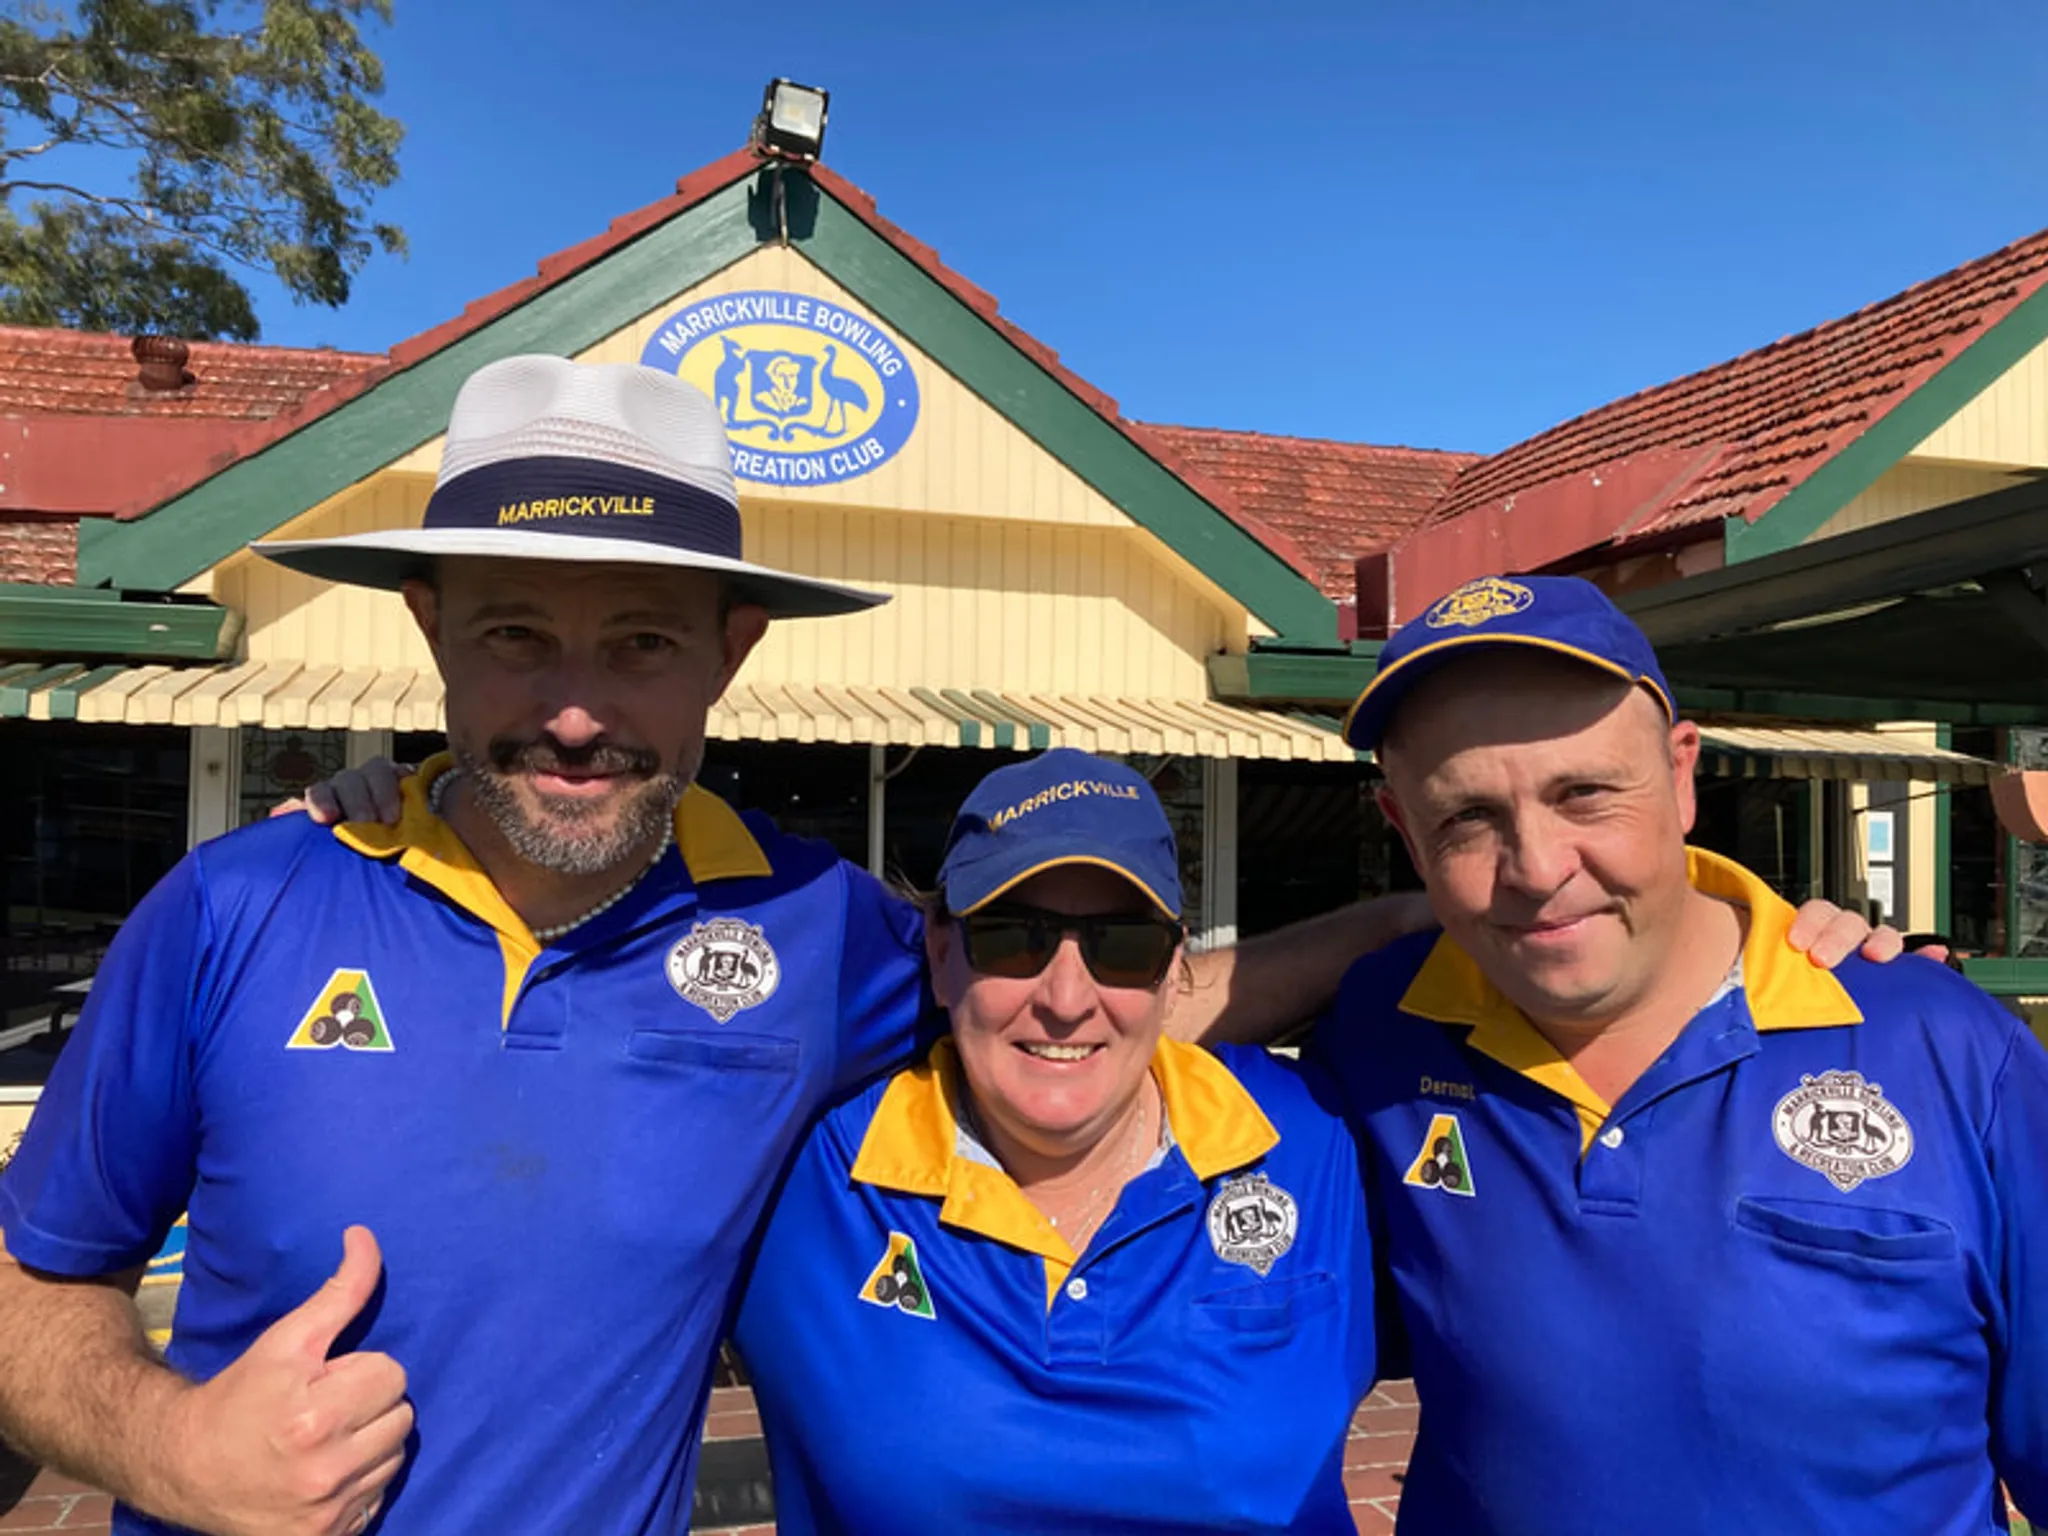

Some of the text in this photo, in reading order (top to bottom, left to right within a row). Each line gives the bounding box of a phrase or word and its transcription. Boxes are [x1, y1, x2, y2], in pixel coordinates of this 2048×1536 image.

[659, 296, 902, 377] MARRICKVILLE BOWLING
[729, 437, 885, 481] REATION CLUB
[497, 496, 655, 526] MARRICKVILLE
[987, 780, 1140, 832] MARRICKVILLE
